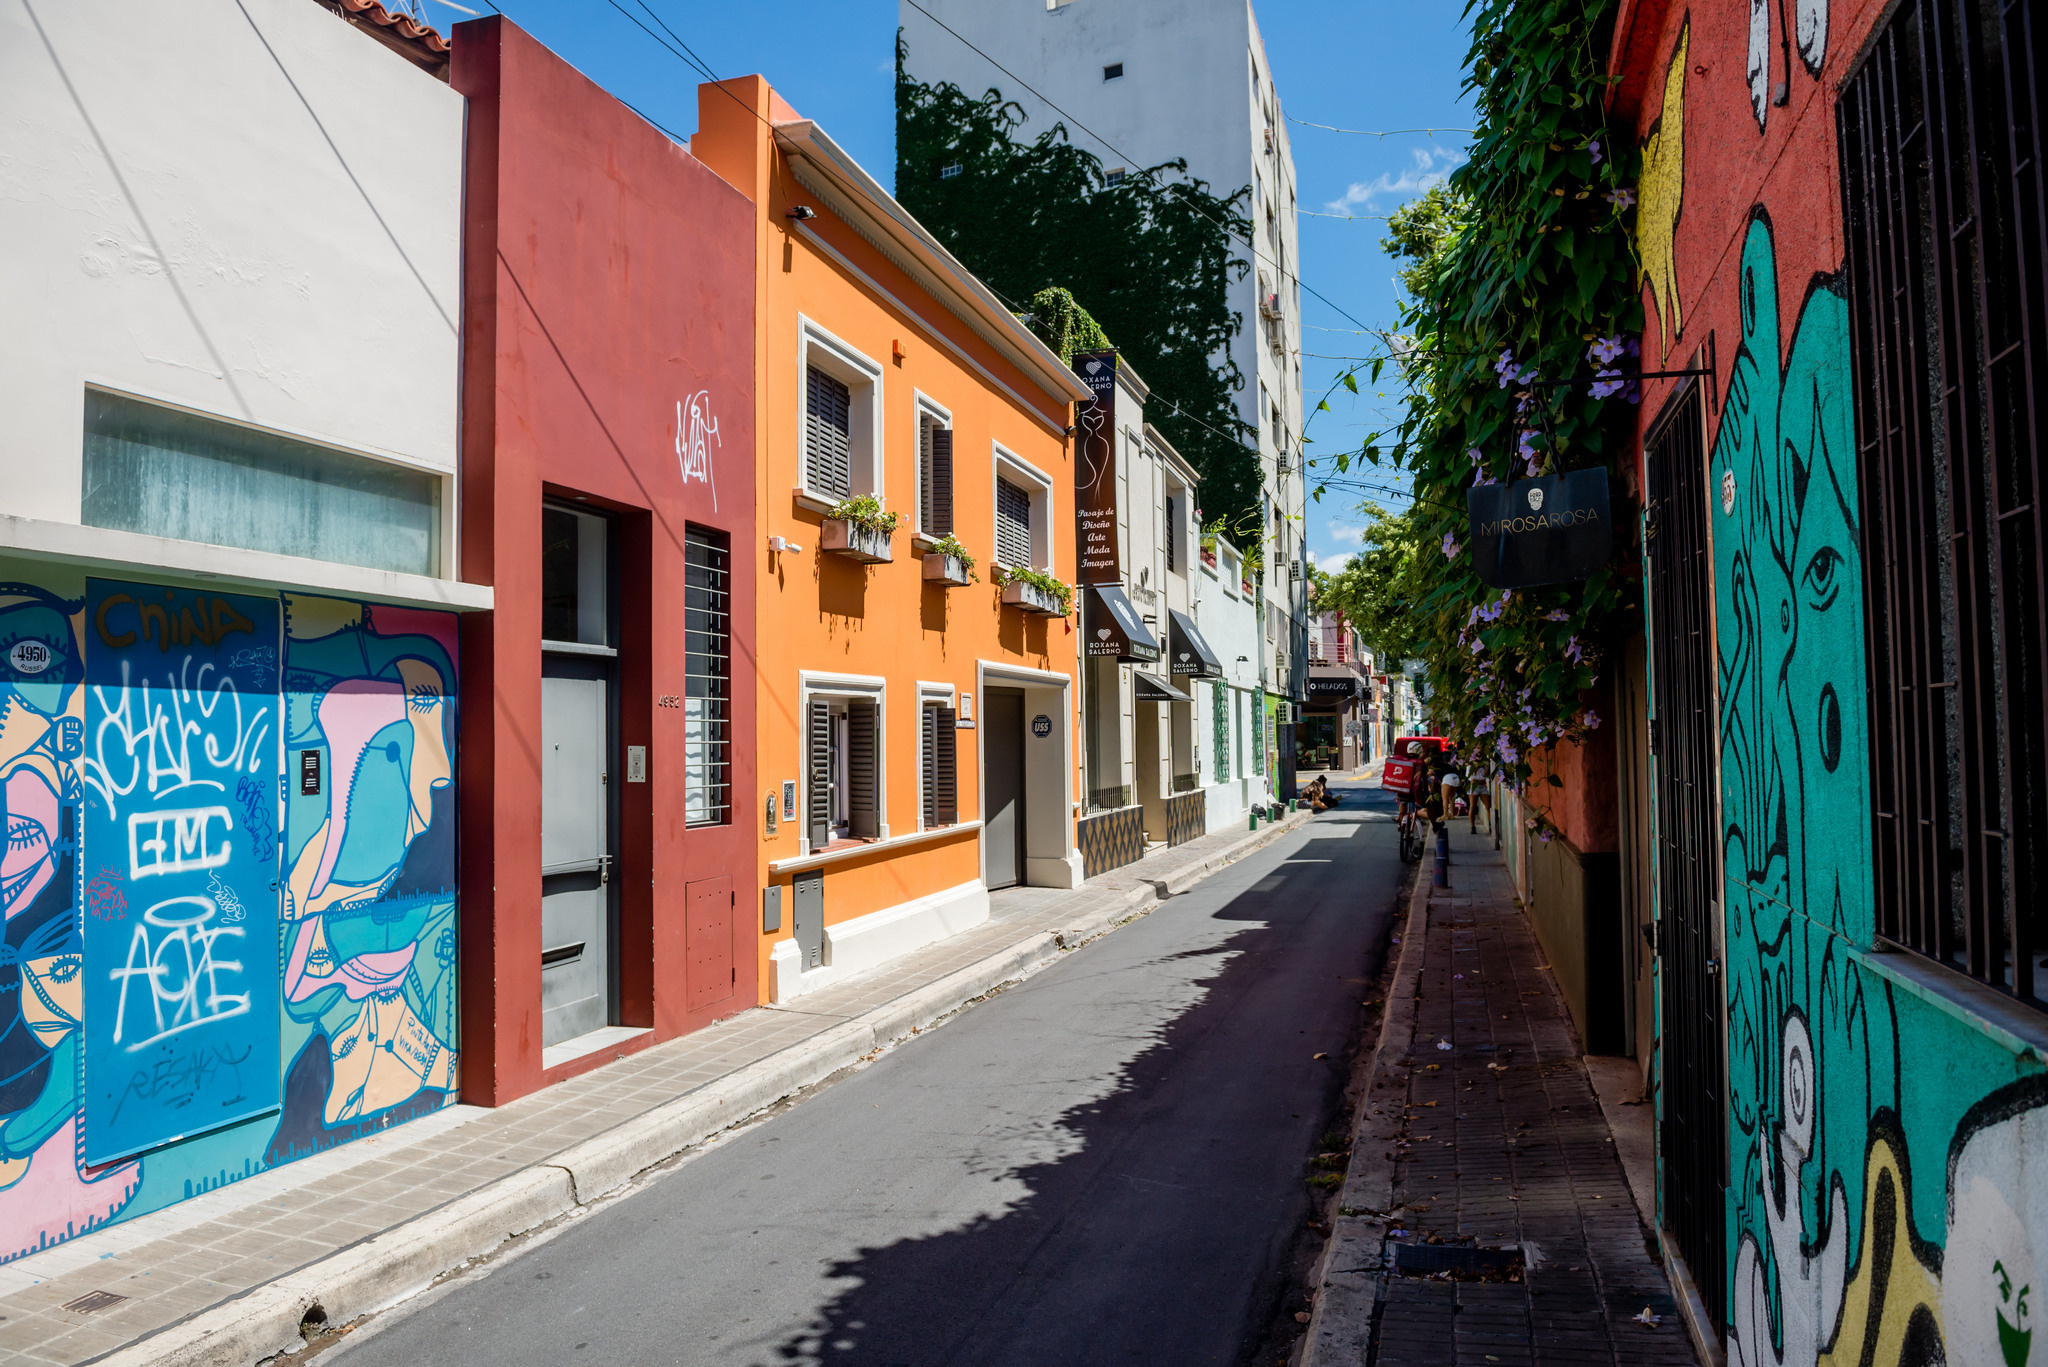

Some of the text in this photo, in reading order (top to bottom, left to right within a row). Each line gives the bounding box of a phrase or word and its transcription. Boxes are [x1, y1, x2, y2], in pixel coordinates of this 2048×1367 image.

[1082, 376, 1110, 384] OXANA
[1090, 382, 1112, 391] ERNO
[1077, 507, 1115, 518] Pasaje de
[1082, 520, 1111, 530] Diseño
[1481, 508, 1600, 537] MIROSAROSA
[1087, 532, 1107, 542] Arte
[1083, 545, 1111, 555] Moda
[1081, 558, 1115, 569] Imagen
[17, 645, 47, 662] 4950
[658, 695, 680, 709] 4952
[1034, 722, 1049, 733] USS
